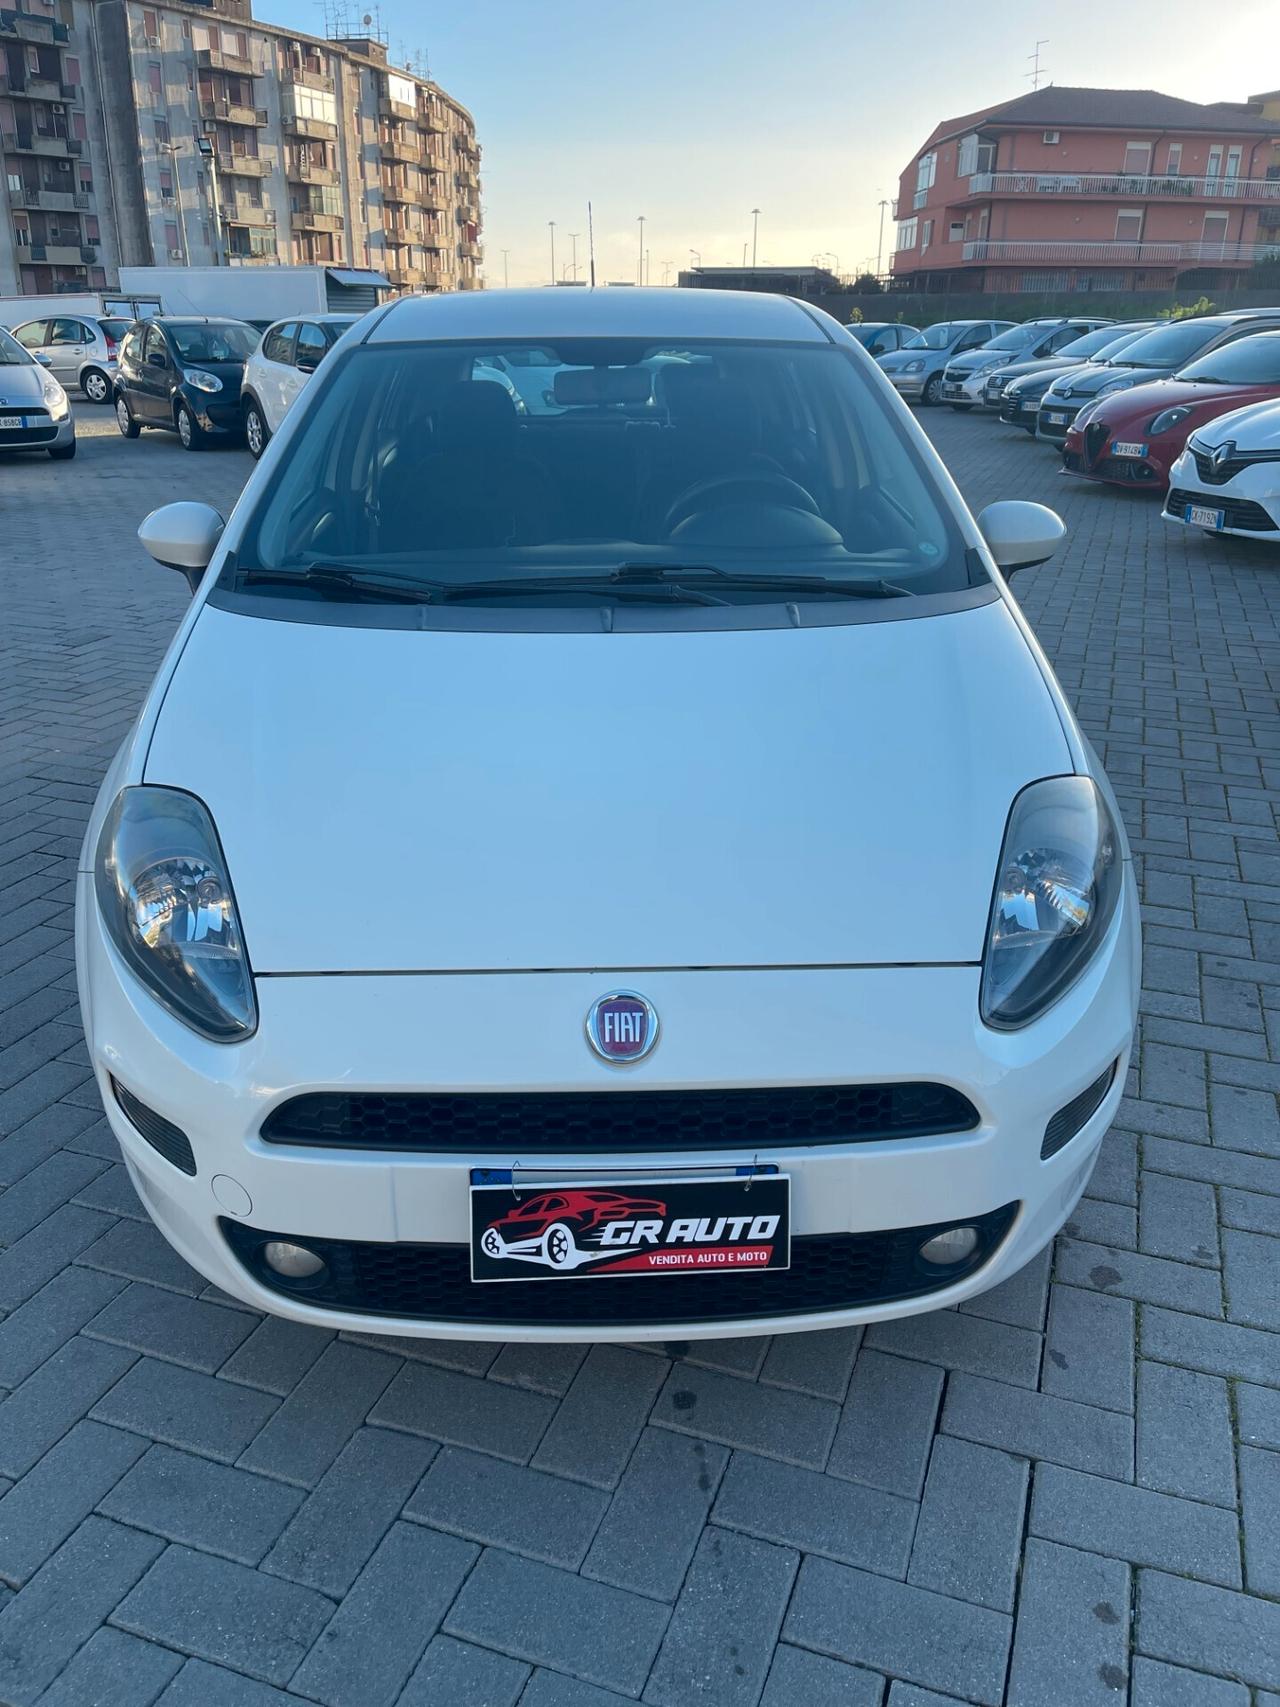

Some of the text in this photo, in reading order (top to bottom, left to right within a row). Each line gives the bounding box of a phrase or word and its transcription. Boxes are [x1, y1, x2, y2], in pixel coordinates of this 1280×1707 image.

[604, 1012, 644, 1043] FIAT
[599, 1215, 780, 1246] GR AUTO
[649, 1251, 767, 1265] VENDITA AUTO E MOTO
